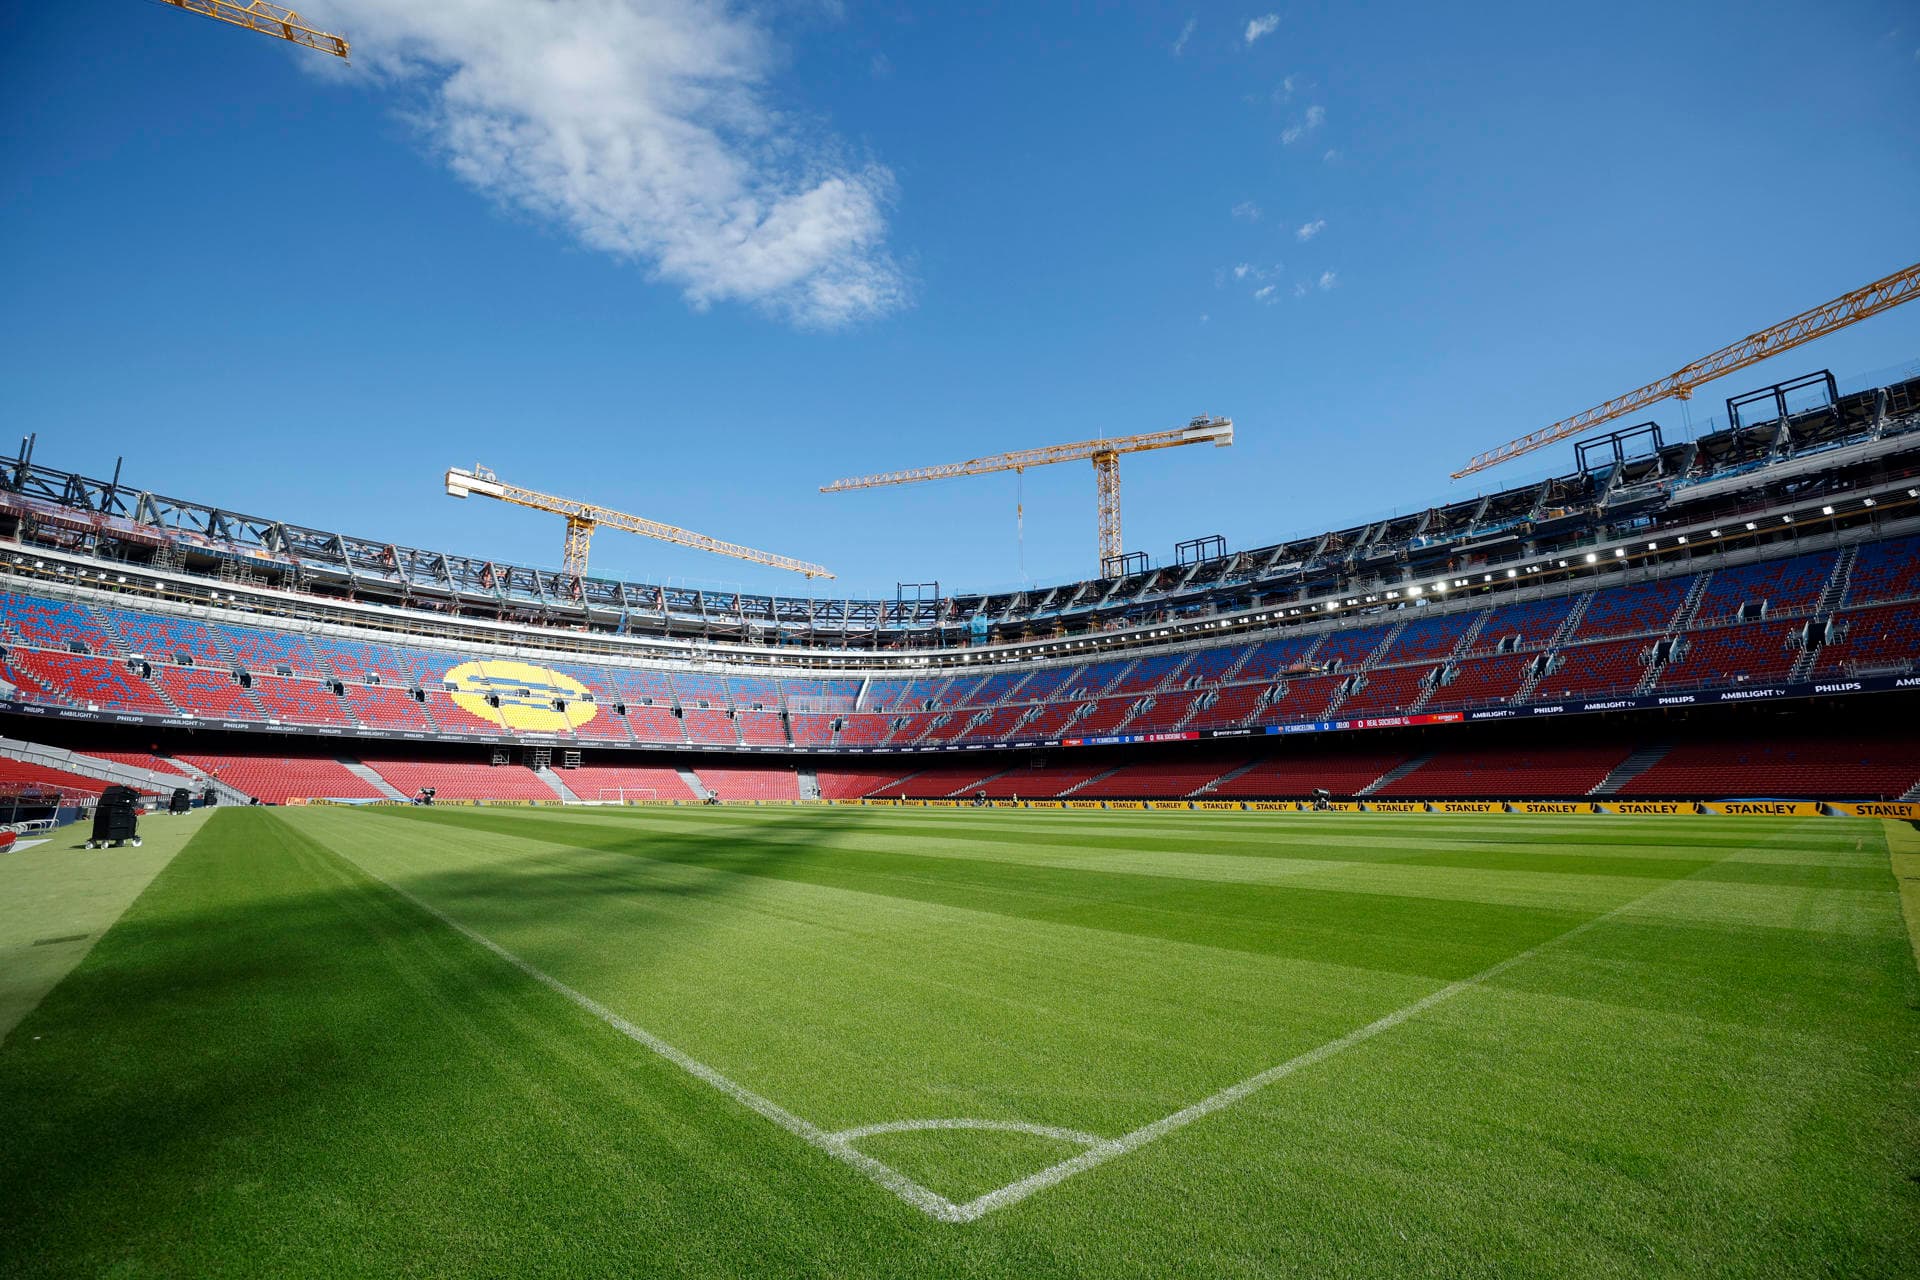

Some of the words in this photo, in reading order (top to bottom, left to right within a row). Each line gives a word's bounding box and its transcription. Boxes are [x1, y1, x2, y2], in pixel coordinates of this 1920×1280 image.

[1815, 683, 1861, 692] PHILIPS
[1721, 690, 1774, 700] AMBILIGHT
[1659, 696, 1695, 704] PHILIPS
[1584, 701, 1626, 710] AMBILIGHT
[60, 710, 92, 719] AMBILIGHT
[1472, 711, 1507, 719] AMBILIGHT
[1619, 805, 1678, 813] STANLEY
[1725, 804, 1796, 814] STANLEY
[1857, 805, 1912, 816] STANLEY
